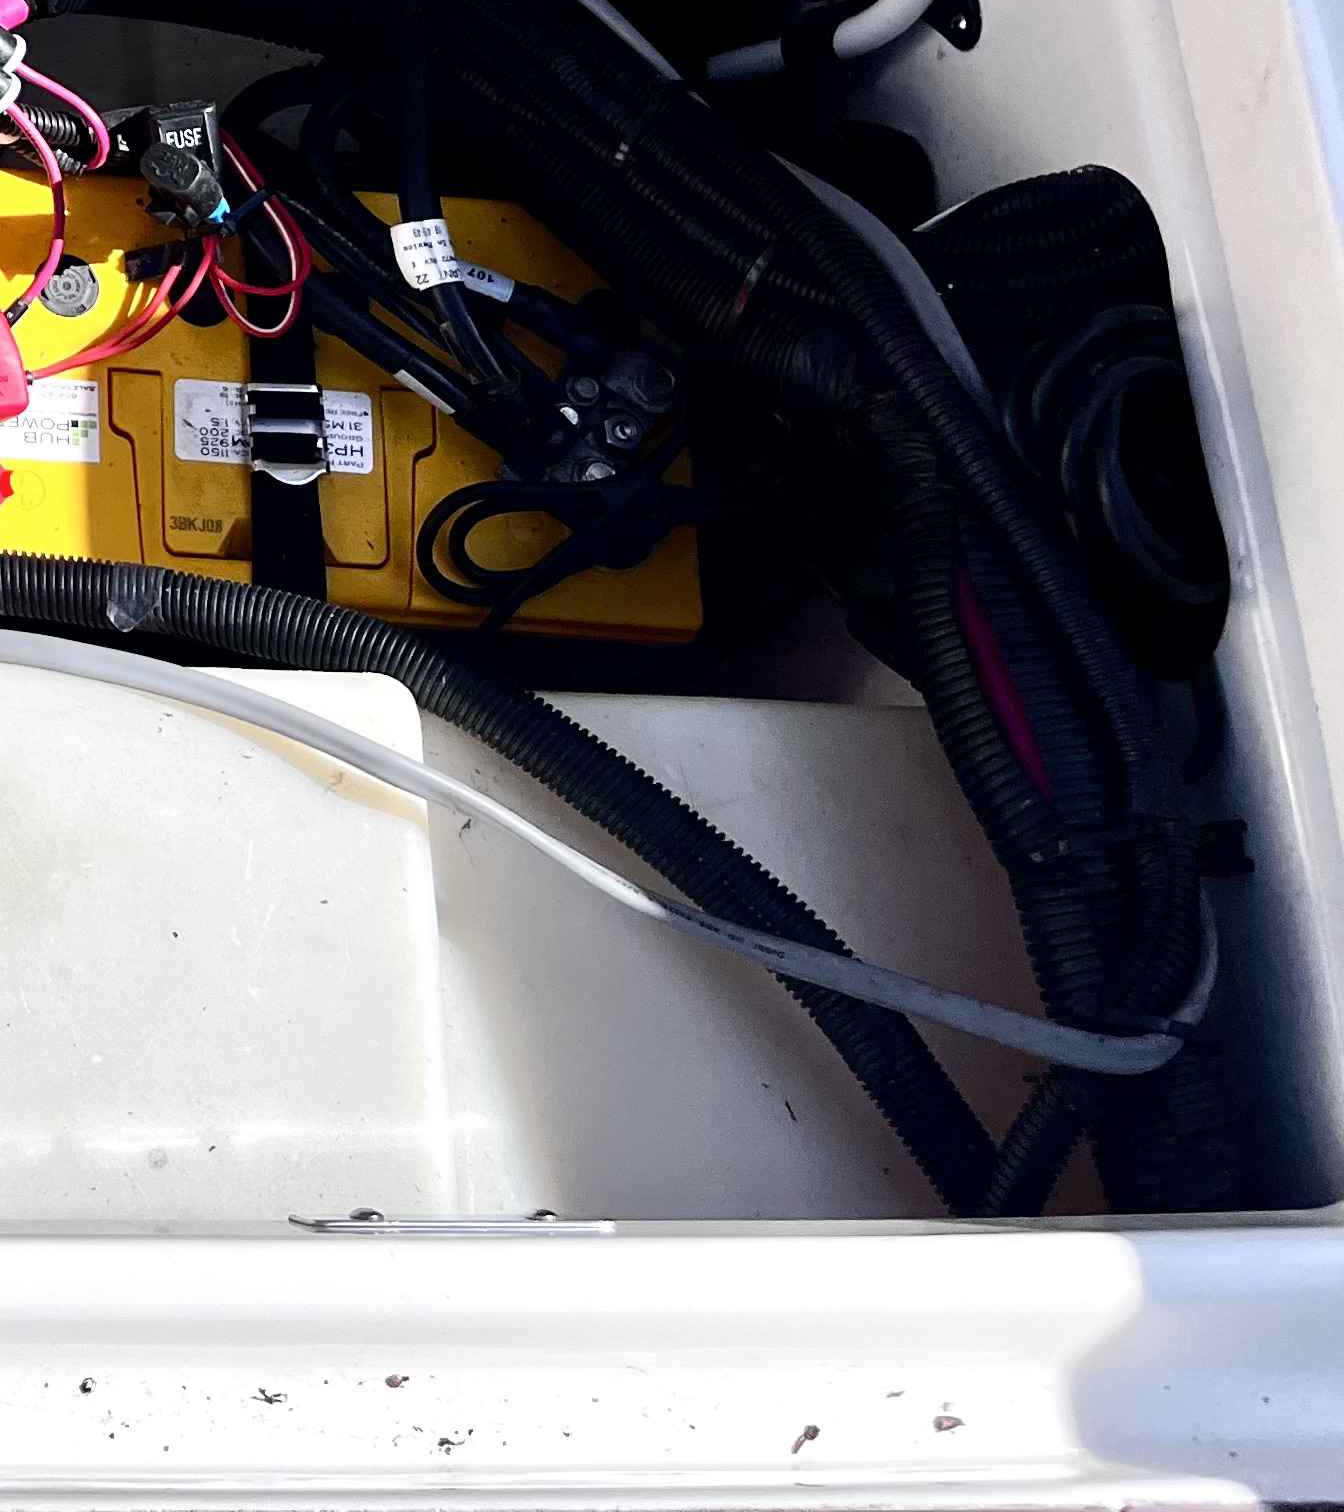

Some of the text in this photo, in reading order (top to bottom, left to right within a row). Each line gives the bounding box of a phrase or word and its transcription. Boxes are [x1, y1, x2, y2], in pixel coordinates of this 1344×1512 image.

[166, 127, 202, 149] FUSE
[467, 267, 496, 283] 107
[0, 417, 70, 431] POWE
[23, 431, 70, 446] HUB
[199, 427, 230, 438] 200
[200, 437, 230, 448] 925
[337, 459, 365, 468] PART
